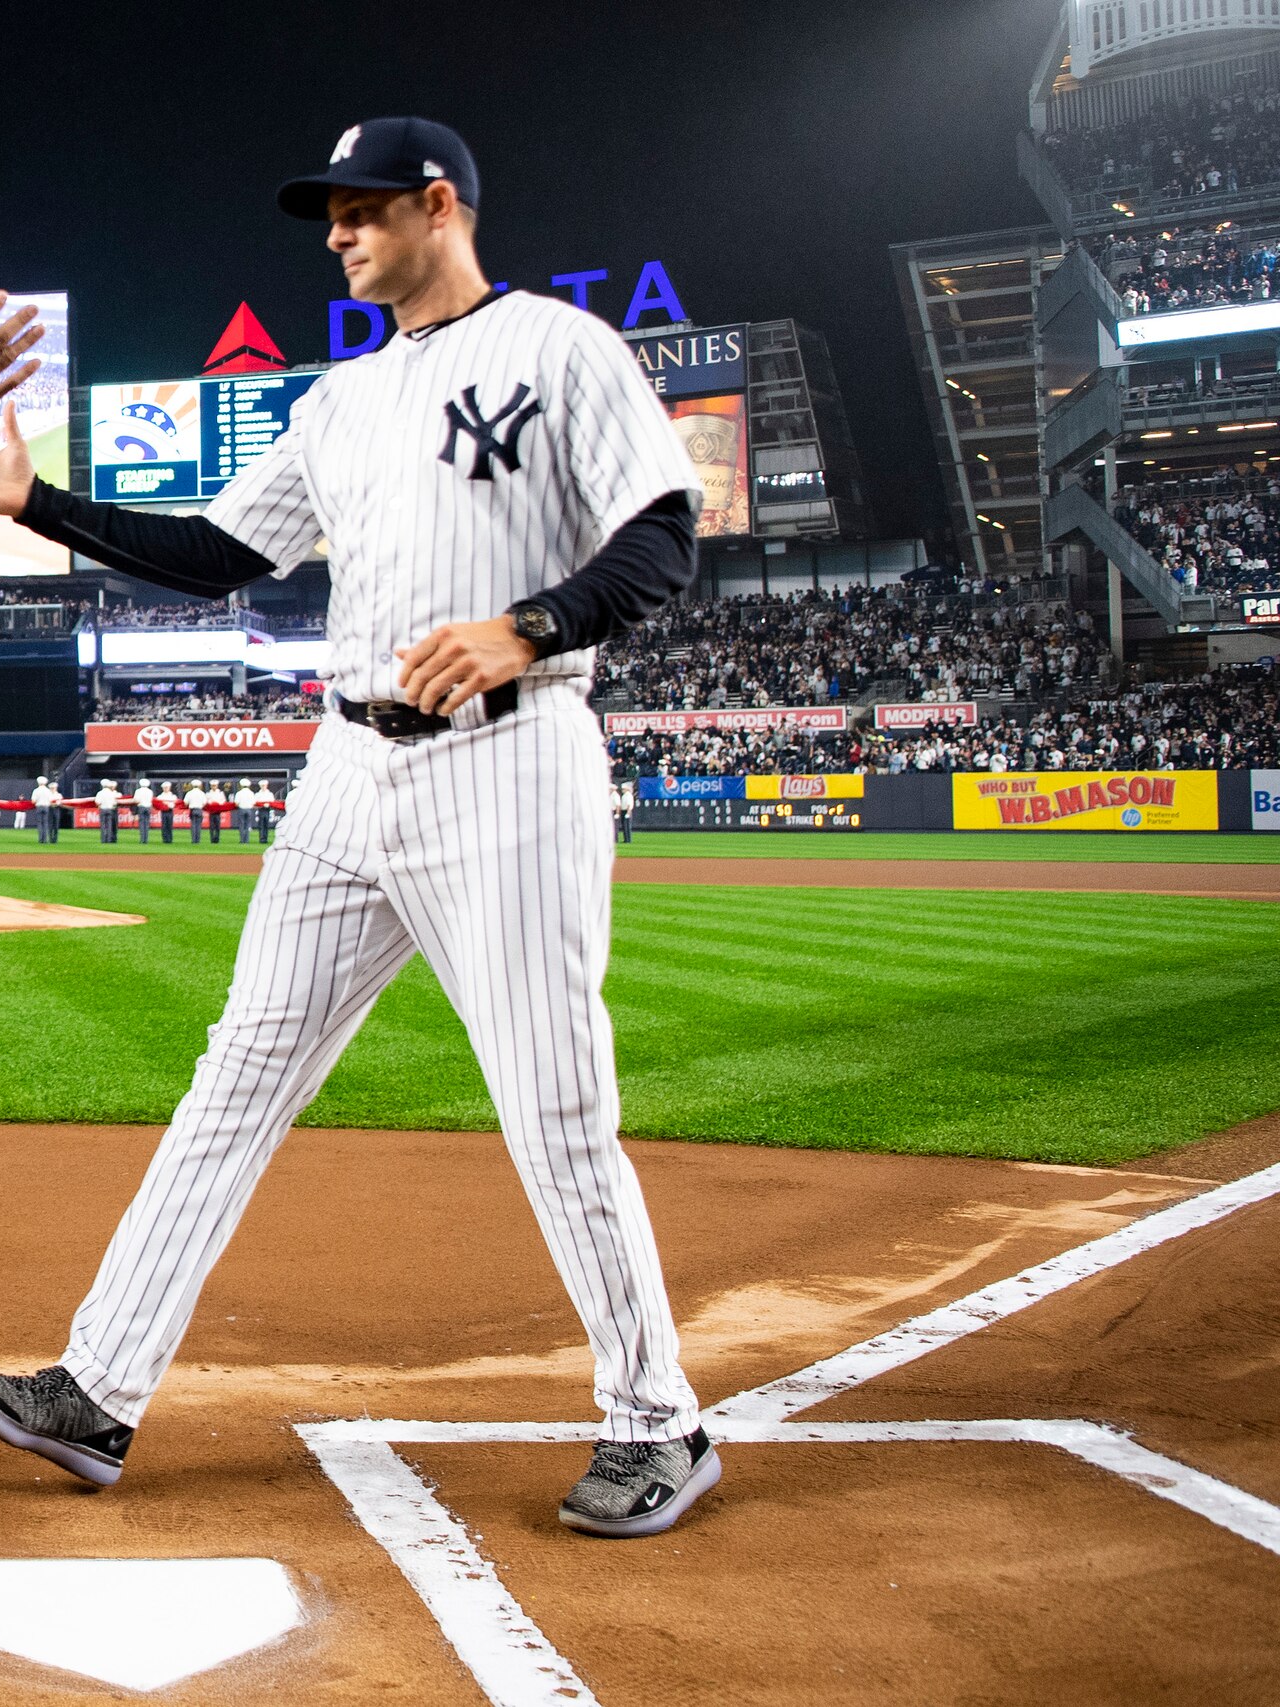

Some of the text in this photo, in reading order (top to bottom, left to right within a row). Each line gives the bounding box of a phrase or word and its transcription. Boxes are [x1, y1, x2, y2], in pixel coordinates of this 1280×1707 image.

[328, 260, 687, 361] DTA
[646, 376, 667, 394] E
[437, 381, 543, 481] NY
[1243, 598, 1280, 616] Par
[612, 714, 686, 731] MODELL'S
[884, 706, 967, 724] MODELL'S
[176, 727, 275, 748] TOYOTA
[680, 777, 723, 795] pepsi
[977, 780, 1037, 795] WHO BUT
[811, 804, 828, 815] POS
[1254, 791, 1280, 812] Ba
[749, 805, 760, 815] AT
[761, 805, 776, 815] BAT
[1125, 809, 1141, 825] hp
[1146, 811, 1180, 819] Preferred
[740, 814, 770, 827] BALL 0
[785, 814, 824, 827] STRIKE 0
[832, 814, 860, 827] OUT 0
[1146, 818, 1173, 826] Partner
